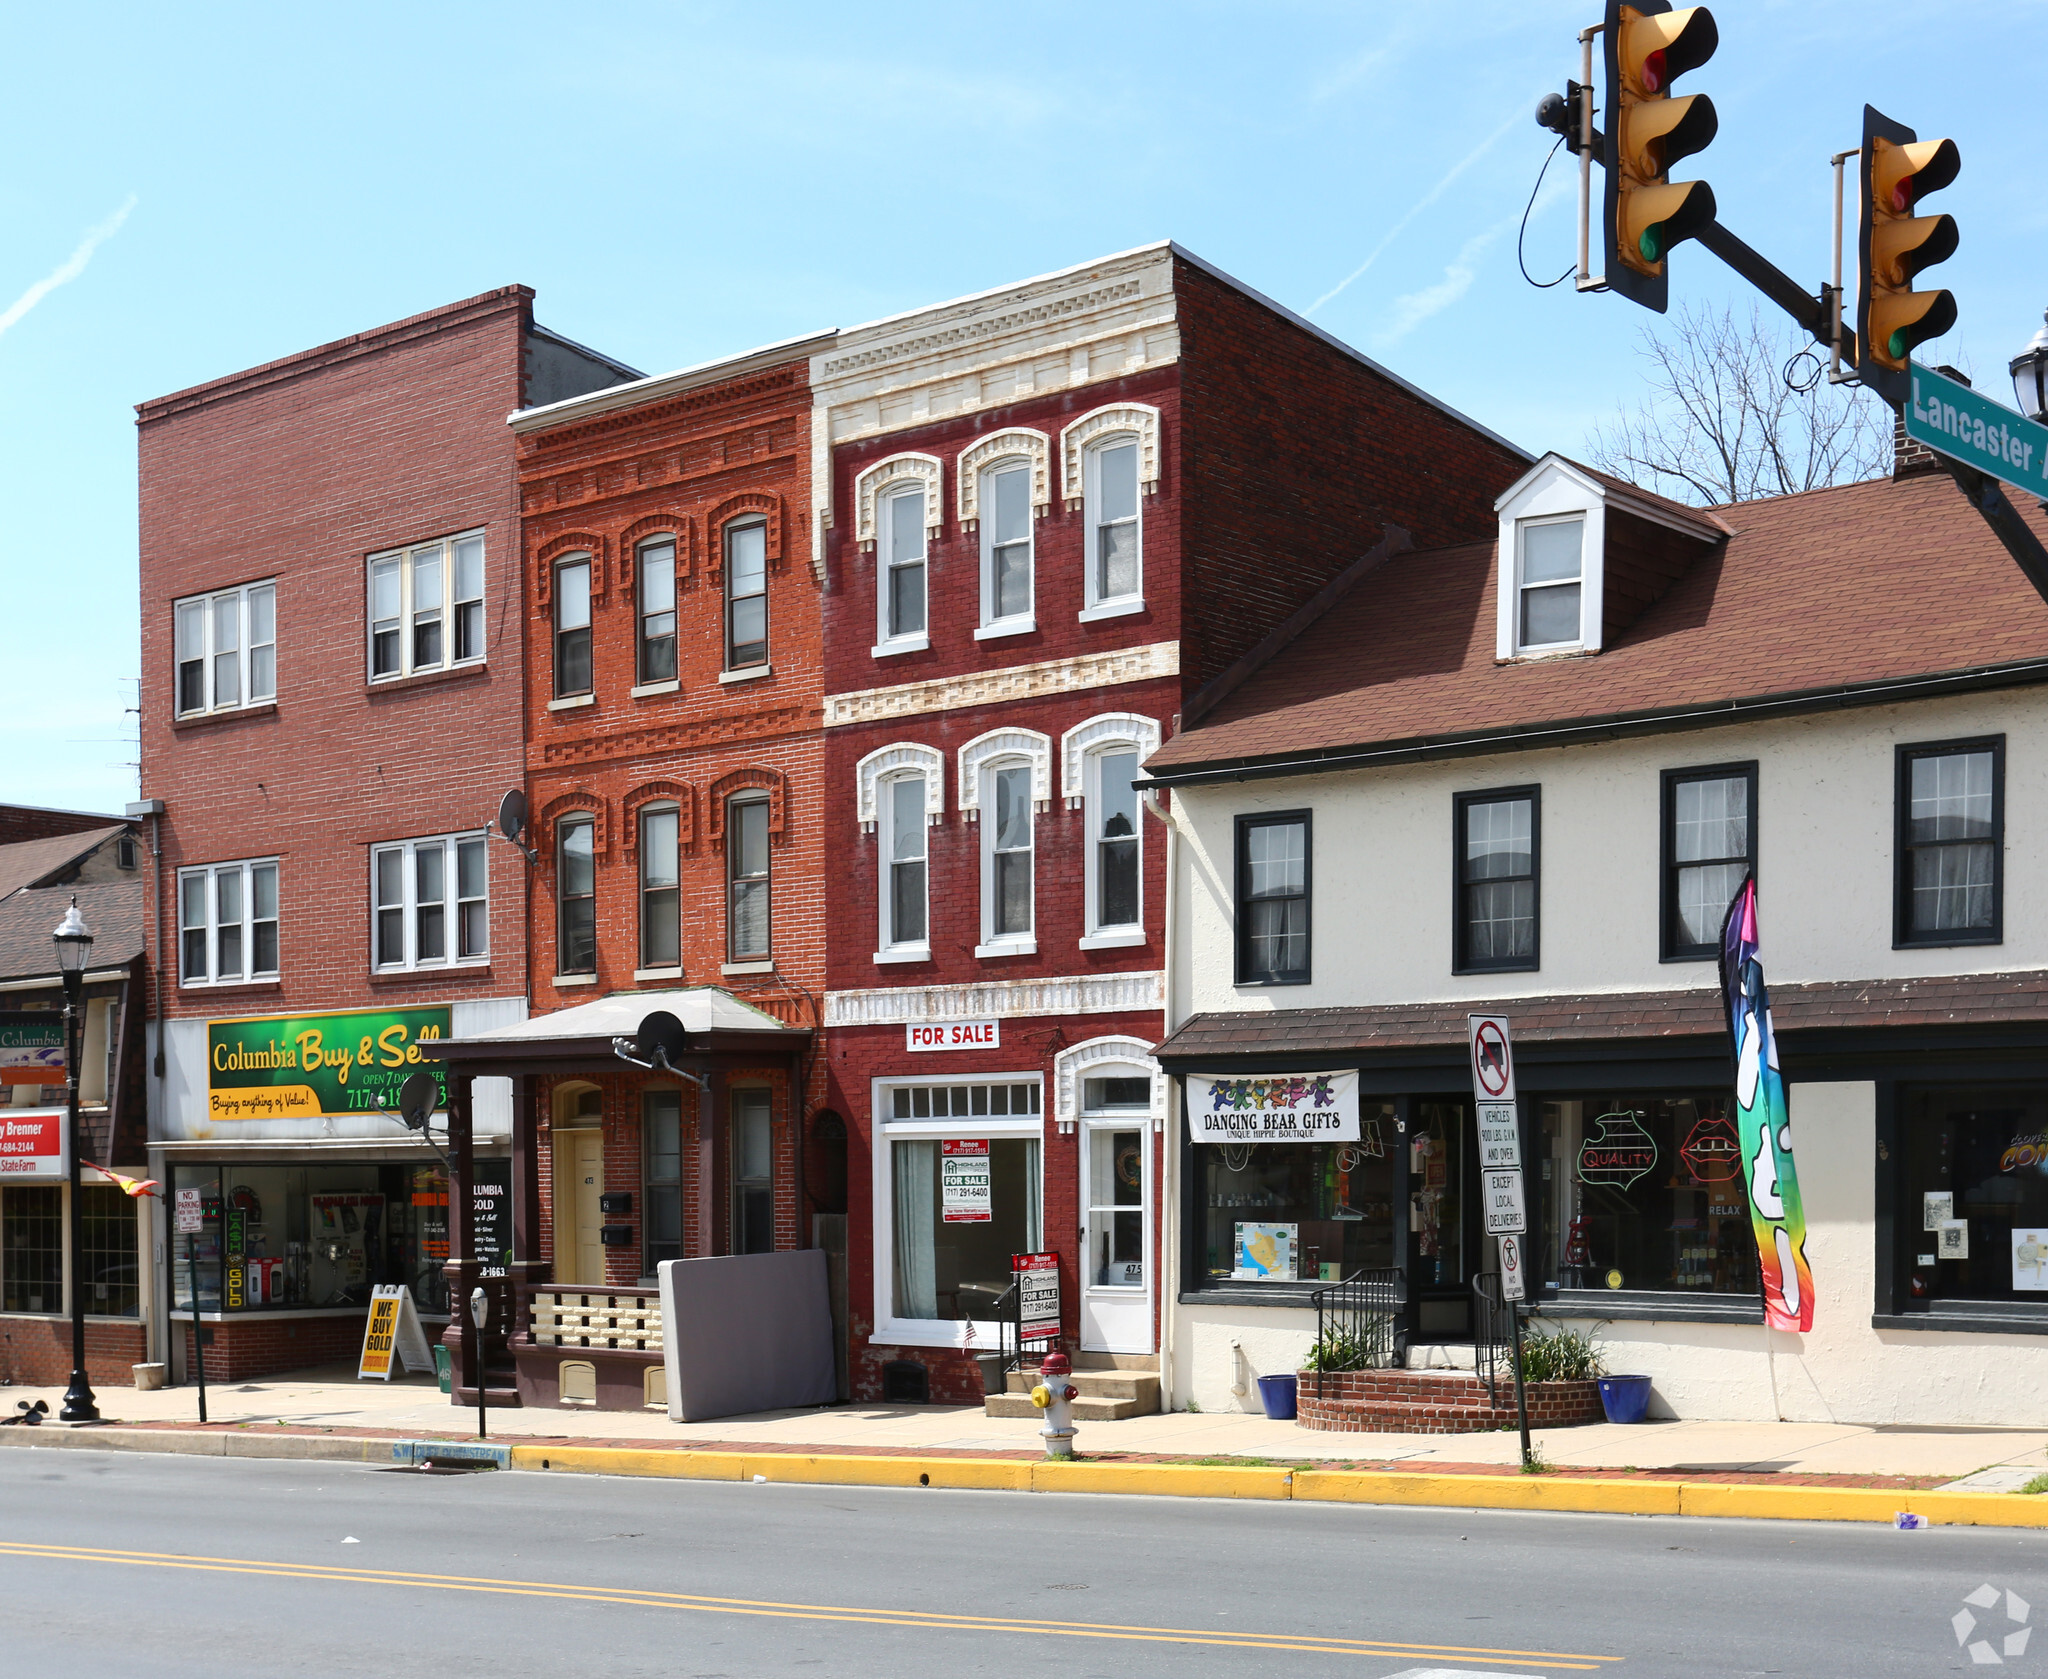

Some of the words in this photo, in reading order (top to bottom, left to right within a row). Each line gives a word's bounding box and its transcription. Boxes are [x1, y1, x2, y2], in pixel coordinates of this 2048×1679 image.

[1913, 377, 2033, 472] Lancaster
[1, 1030, 61, 1047] Columbia
[913, 1027, 944, 1045] FOR
[952, 1025, 993, 1043] SALE
[213, 1039, 297, 1072] Columbia
[295, 1029, 353, 1084] Buy
[357, 1036, 374, 1066] &
[363, 1074, 385, 1085] OPEN
[386, 1071, 394, 1086] 7
[211, 1095, 240, 1115] Buying
[242, 1094, 273, 1114] anything
[275, 1094, 283, 1112] of
[285, 1090, 309, 1107] Value!
[1204, 1113, 1257, 1130] DANCING
[1264, 1113, 1297, 1129] BEAR
[1303, 1112, 1340, 1129] GIFTS
[1485, 1111, 1510, 1122] VEHICLES
[7, 1121, 43, 1136] Brenner
[1227, 1130, 1250, 1138] UNIQUE
[1253, 1130, 1275, 1138] HIPPIE
[1279, 1129, 1315, 1138] BOUTIQUE
[1488, 1148, 1498, 1160] AND
[1500, 1147, 1513, 1160] OVER
[1583, 1151, 1653, 1167] QUALITY
[945, 1176, 962, 1185] FOR
[965, 1176, 987, 1185] SALE
[1492, 1176, 1514, 1189] EXCEPT
[183, 1191, 193, 1200] NO
[473, 1184, 503, 1196] LUMBIA
[945, 1188, 958, 1197] (717)
[960, 1188, 988, 1197] 291-6400
[178, 1201, 201, 1209] PARKING
[1495, 1195, 1514, 1207] LOCAL
[1709, 1206, 1741, 1215] RELAX
[1490, 1213, 1522, 1227] DELIVERIES
[229, 1212, 242, 1251] CASH
[480, 1266, 506, 1277] 8-1663
[1126, 1265, 1142, 1274] 475
[1509, 1275, 1516, 1284] NO
[229, 1269, 242, 1307] GOLD
[1022, 1292, 1037, 1302] FOR
[1039, 1289, 1056, 1299] SALE
[377, 1302, 393, 1318] WE
[1035, 1301, 1057, 1312] 291-6400
[372, 1318, 392, 1334] BUY
[367, 1335, 392, 1351] GOLD
